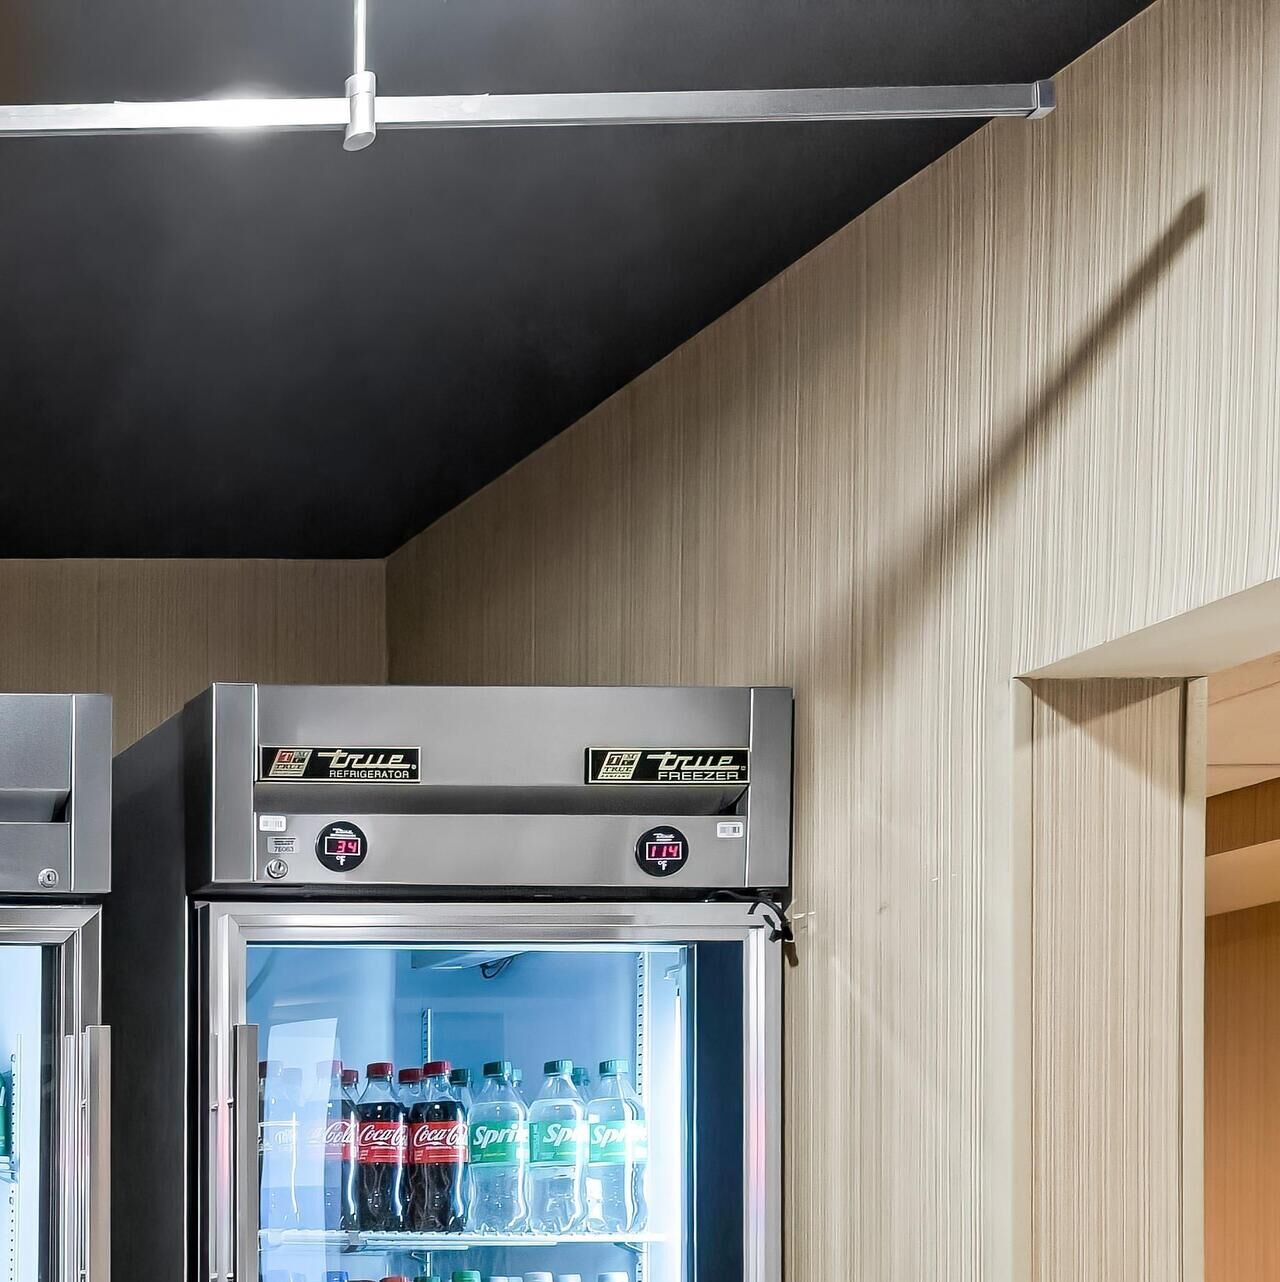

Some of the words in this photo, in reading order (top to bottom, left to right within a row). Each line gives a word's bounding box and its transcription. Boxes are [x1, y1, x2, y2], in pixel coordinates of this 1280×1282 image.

[318, 749, 410, 769] true
[647, 752, 740, 771] true
[329, 769, 410, 779] REFRIGERATOR
[658, 771, 739, 781] FREEZER
[336, 840, 357, 853] 34
[651, 845, 679, 857] 114
[335, 855, 347, 866] °F
[657, 860, 668, 871] °F
